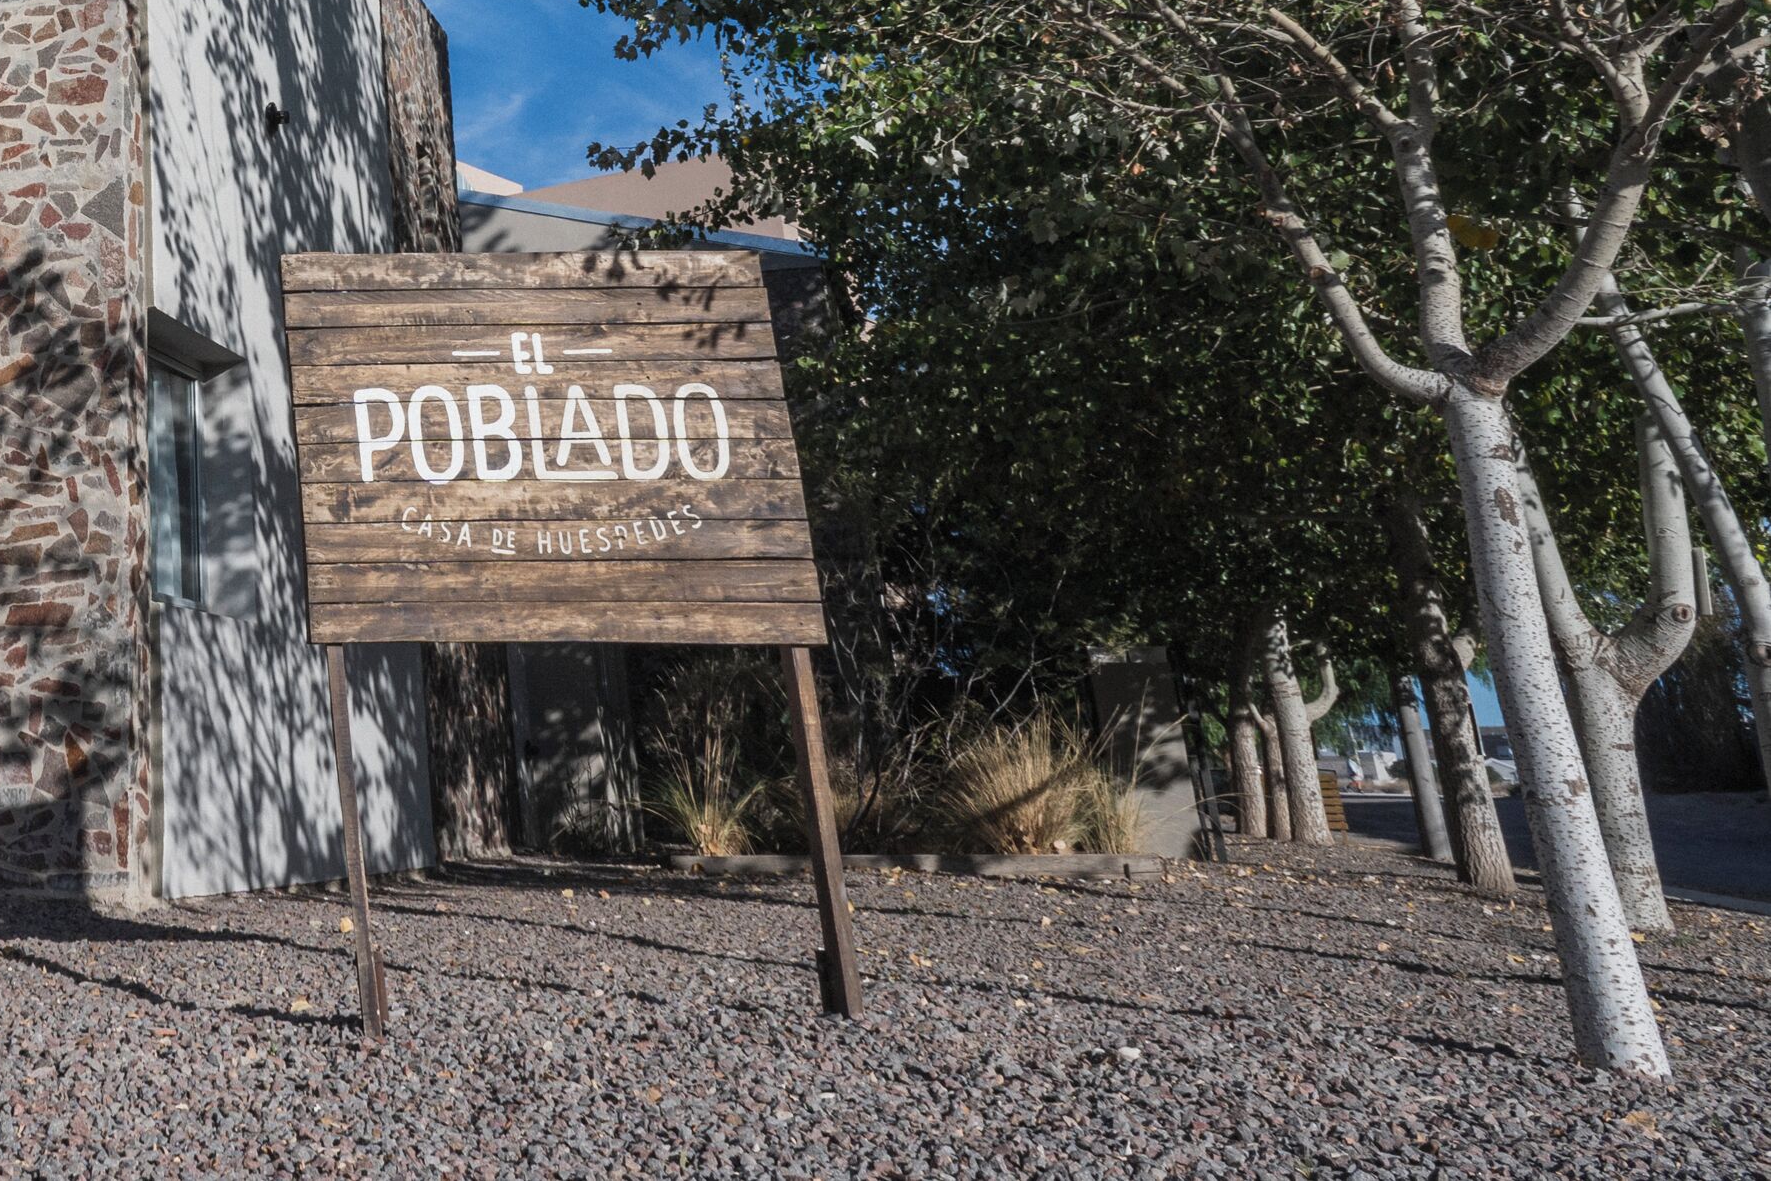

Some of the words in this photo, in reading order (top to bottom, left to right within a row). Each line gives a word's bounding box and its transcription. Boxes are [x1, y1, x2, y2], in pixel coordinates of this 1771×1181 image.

[510, 331, 555, 375] EL
[352, 382, 731, 485] POBLADO
[401, 506, 473, 548] CASA
[491, 528, 517, 550] DE
[536, 504, 703, 555] HUESPEDES
